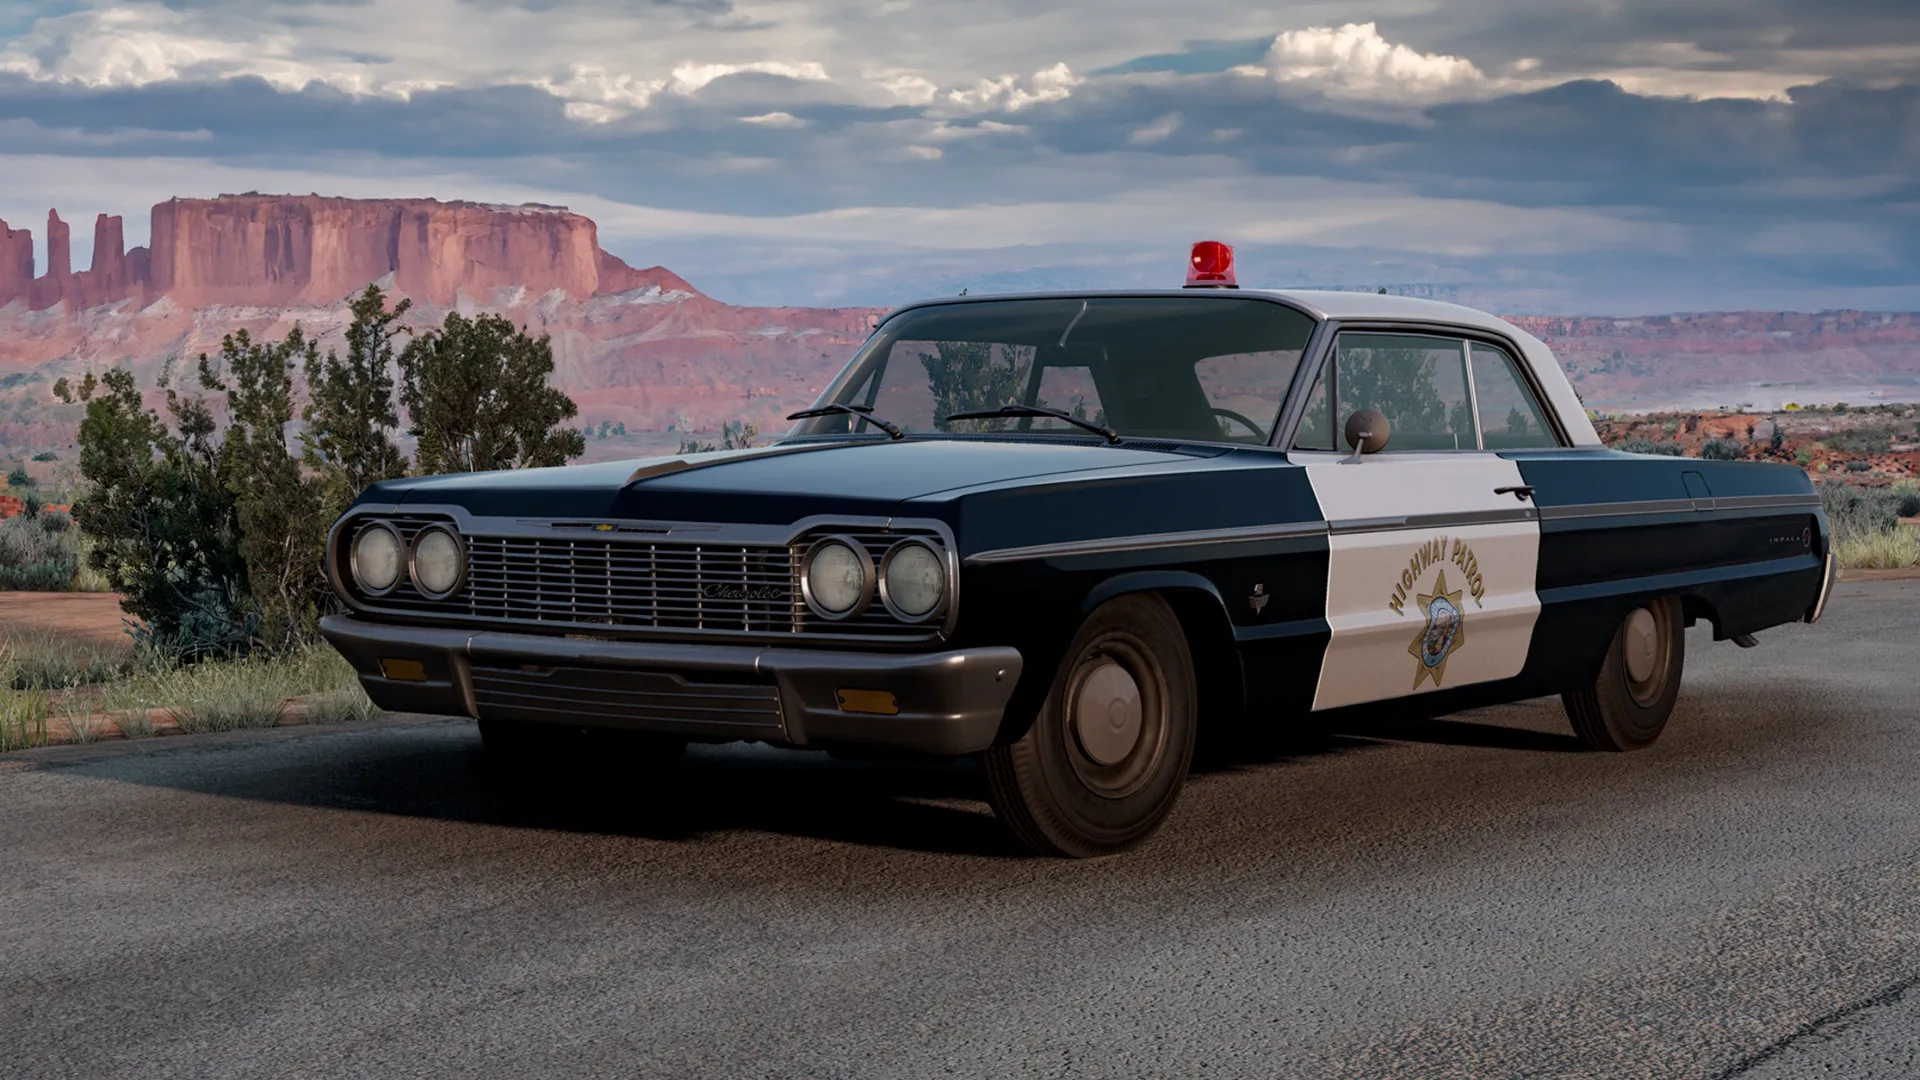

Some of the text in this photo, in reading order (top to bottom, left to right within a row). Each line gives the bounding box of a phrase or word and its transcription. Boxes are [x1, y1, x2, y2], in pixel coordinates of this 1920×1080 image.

[703, 583, 781, 599] Chevrolet
[1389, 535, 1486, 616] HIGHWAY PATROL
